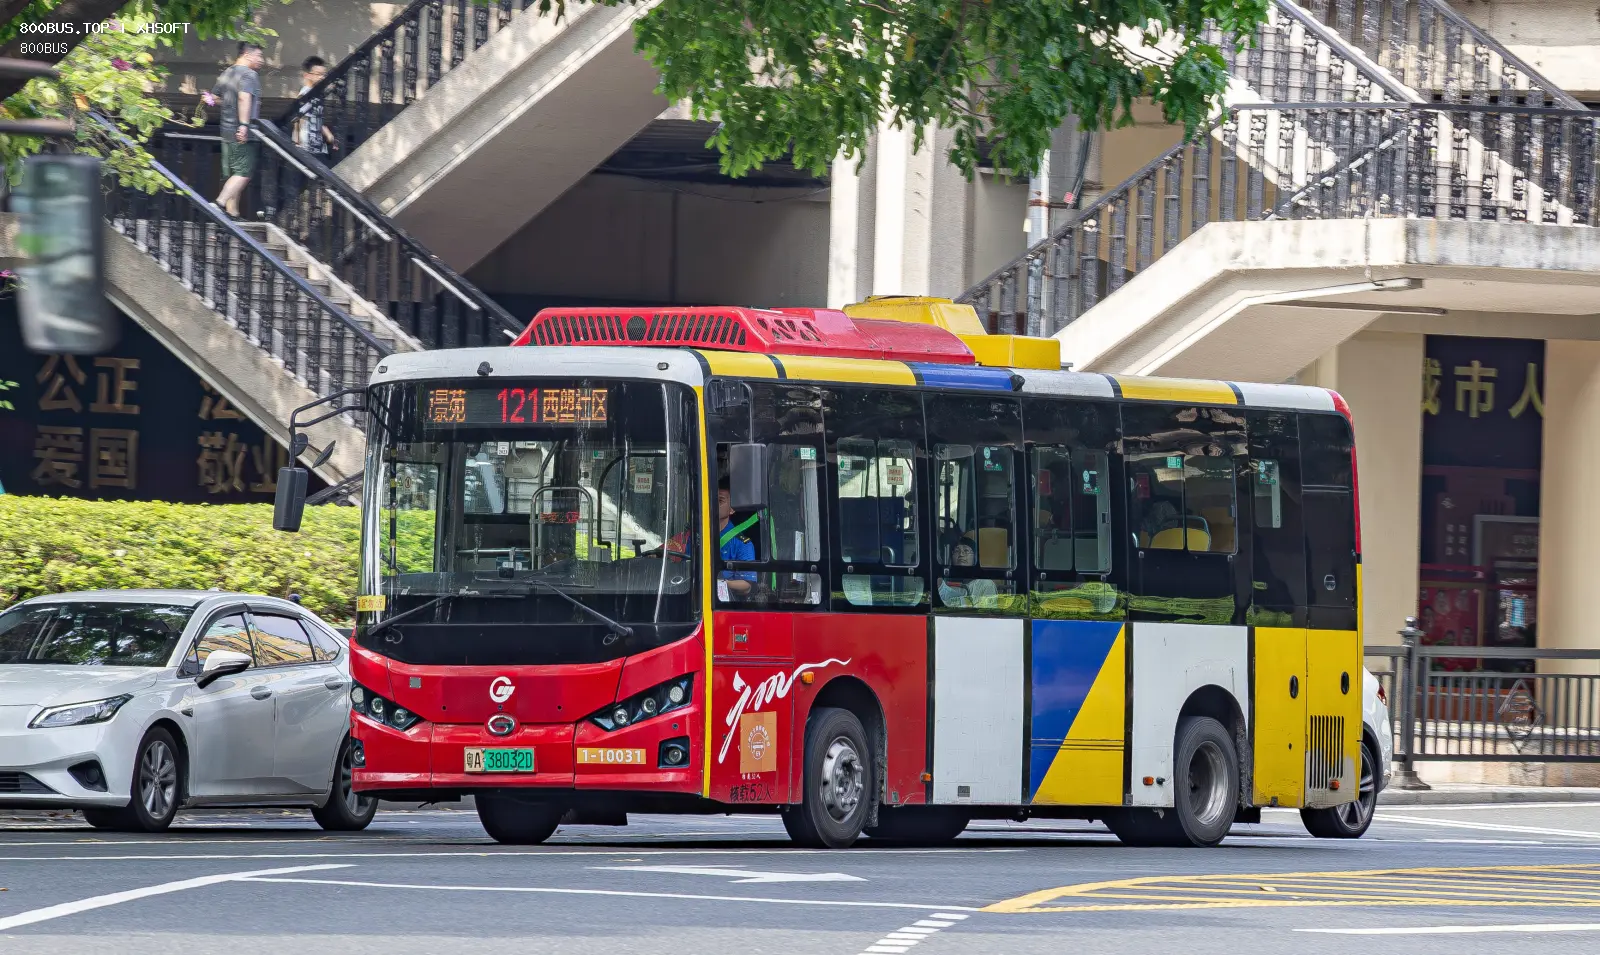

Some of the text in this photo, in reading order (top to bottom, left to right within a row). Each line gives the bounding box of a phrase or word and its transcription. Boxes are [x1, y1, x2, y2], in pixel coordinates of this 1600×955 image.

[36, 354, 141, 415] 公正
[498, 388, 539, 423] 121
[33, 424, 139, 490] 爱国
[581, 748, 642, 764] 1-10031
